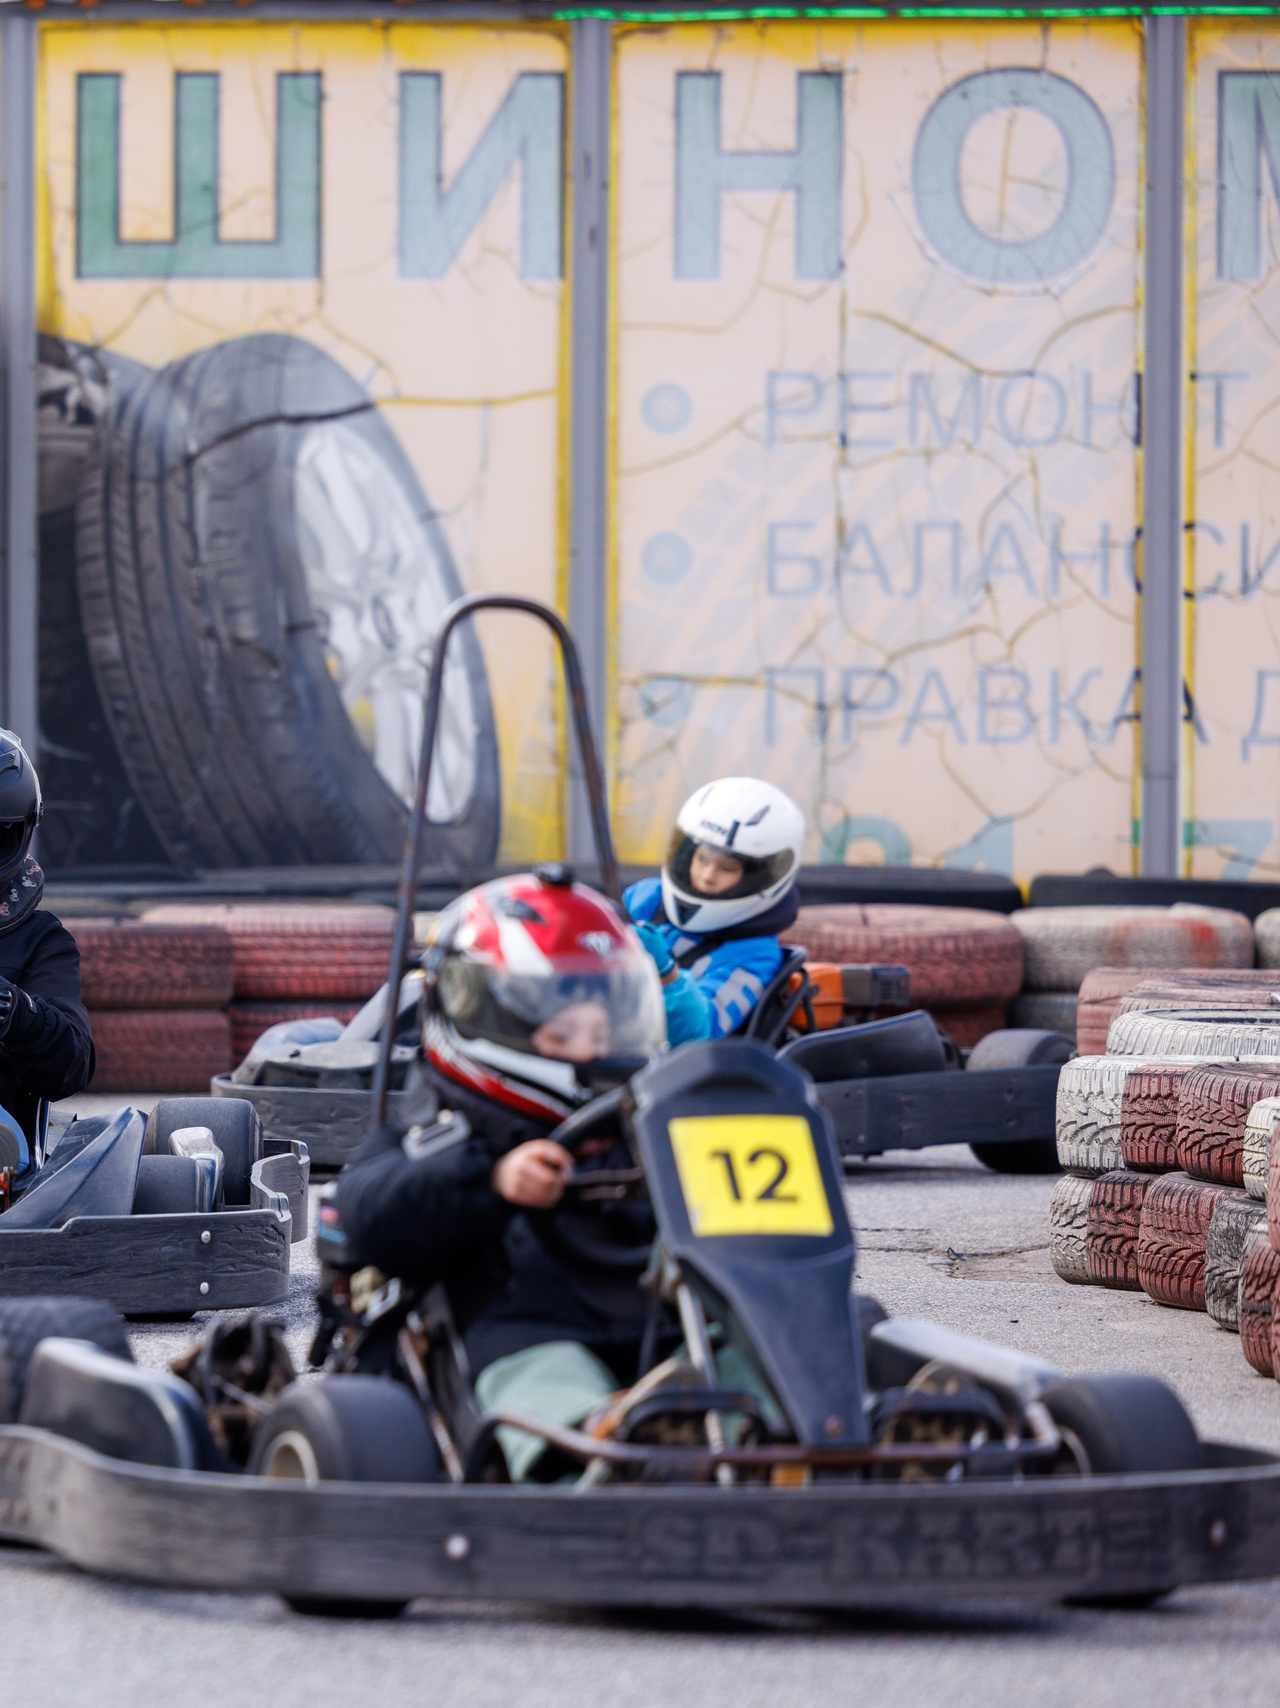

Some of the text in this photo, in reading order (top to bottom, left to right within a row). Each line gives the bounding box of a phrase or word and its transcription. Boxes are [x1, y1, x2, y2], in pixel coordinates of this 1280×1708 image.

[765, 370, 1250, 448] РЕМОНТ
[766, 668, 1208, 746] ПРАВКА
[708, 1147, 800, 1204] 12
